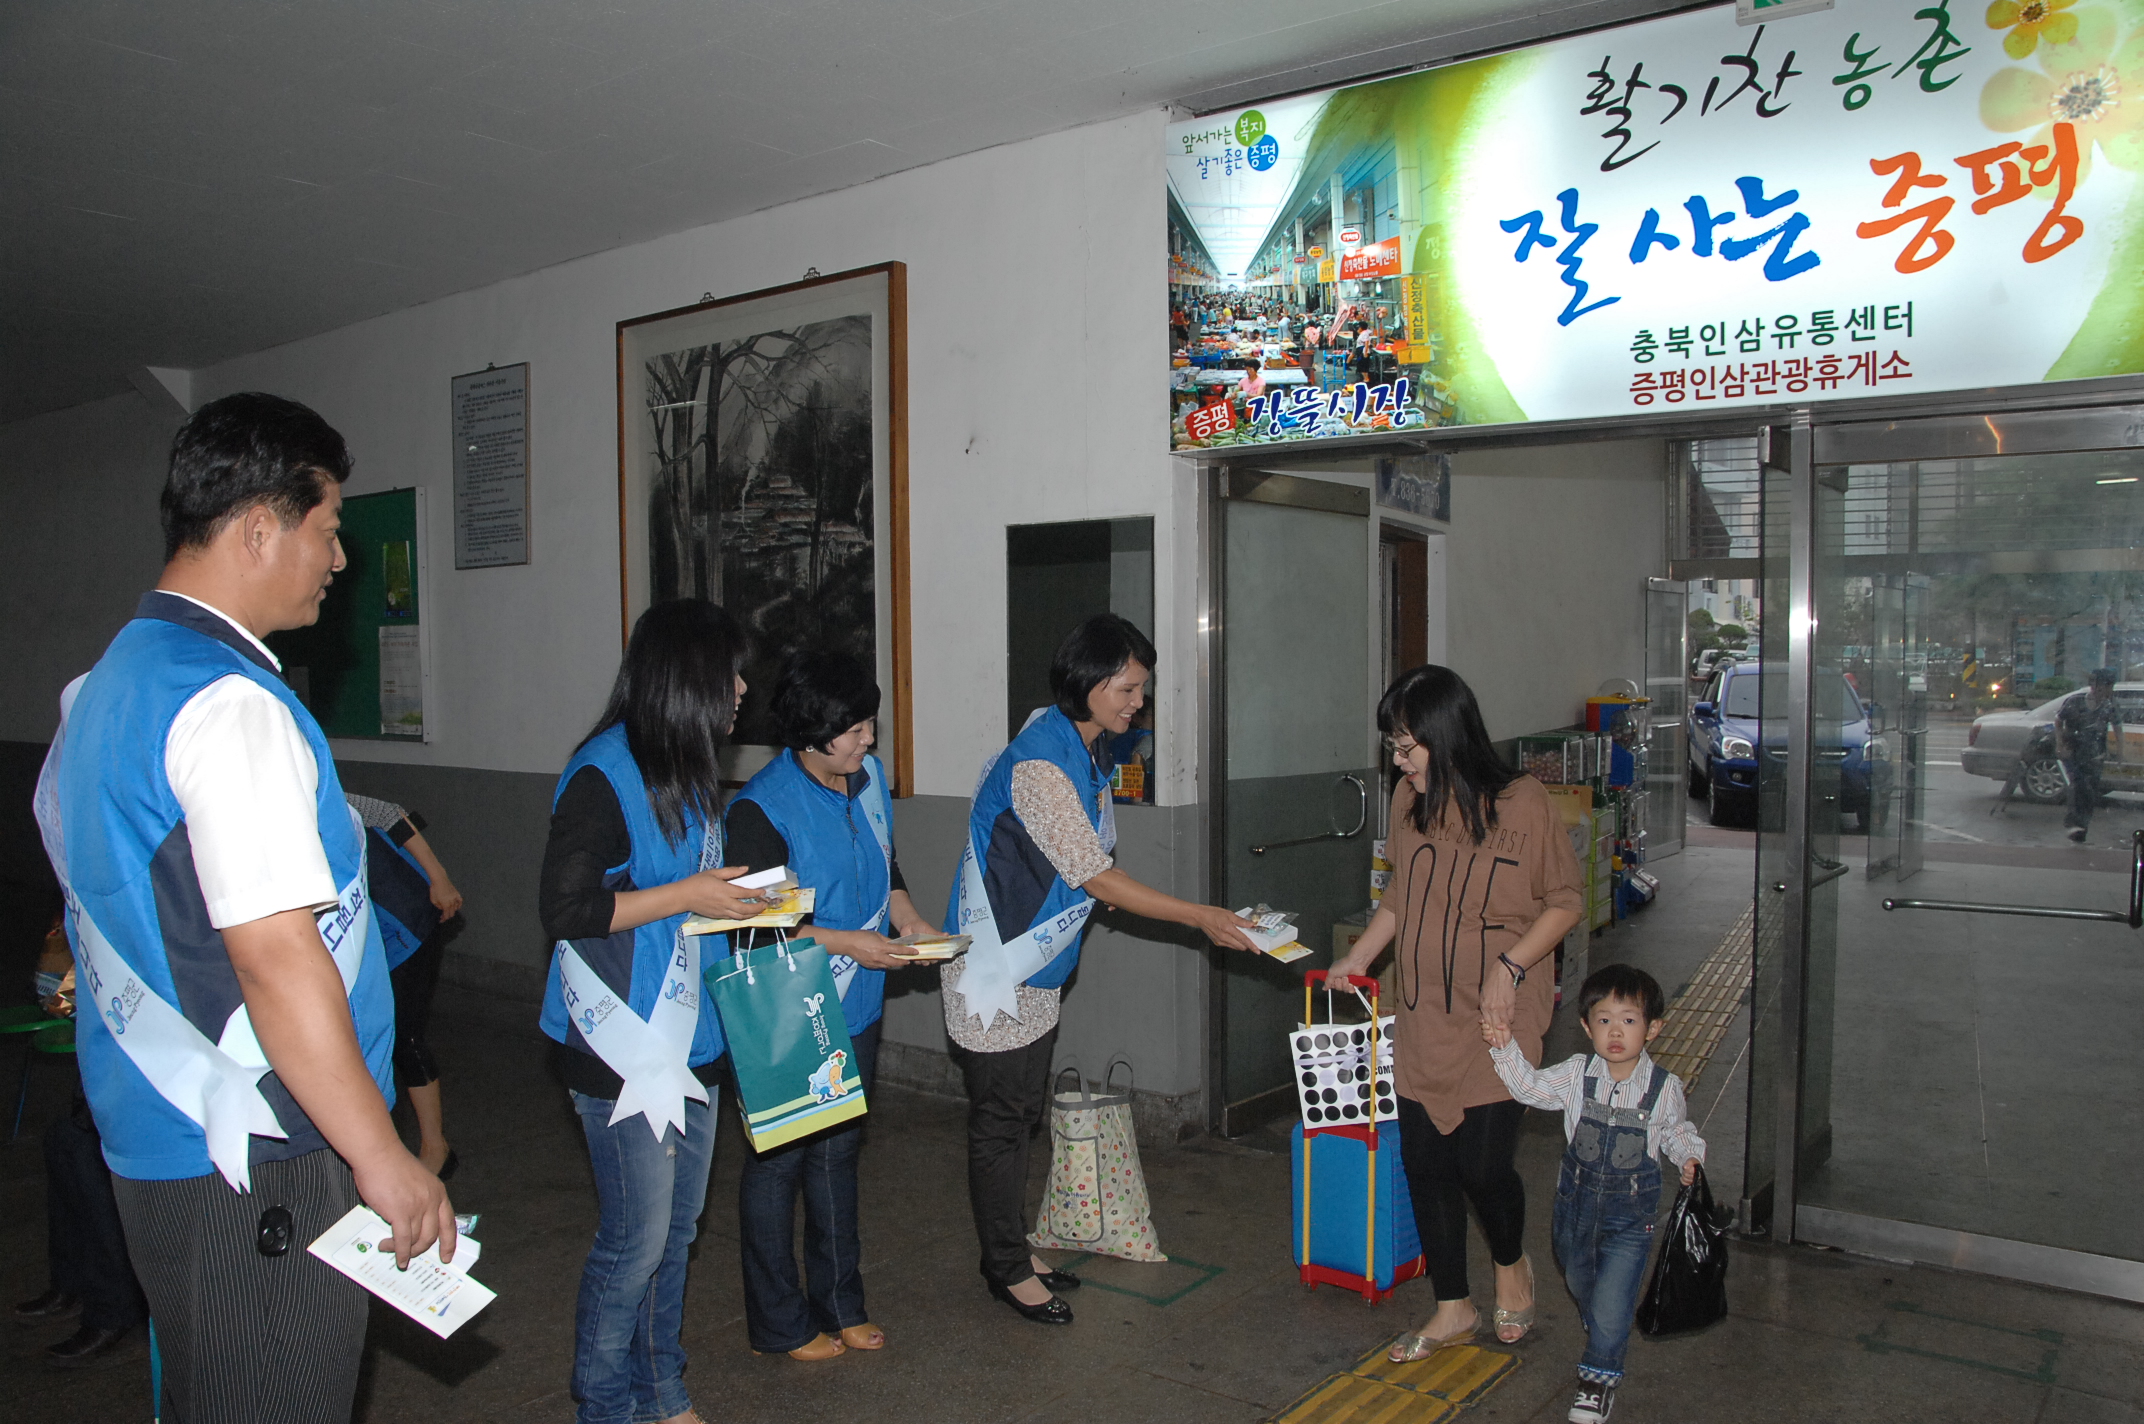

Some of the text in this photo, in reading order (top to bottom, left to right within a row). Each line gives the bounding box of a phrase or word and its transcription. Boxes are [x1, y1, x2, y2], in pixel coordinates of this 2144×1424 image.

[1580, 0, 1971, 172] 활기찬 농촌
[1182, 117, 1263, 154] 앞서가는 복지
[1196, 142, 1276, 180] 살기좋은 증평
[1500, 188, 1621, 326] 잘
[1630, 176, 1821, 281] 사는
[1858, 123, 2083, 273] 증평
[1630, 303, 1914, 363] 충북인삼유통센터
[1629, 351, 1914, 405] 증평인삼관광휴게소
[1193, 378, 1411, 438] 증평 장뜰시장
[595, 994, 615, 1016] 증평군
